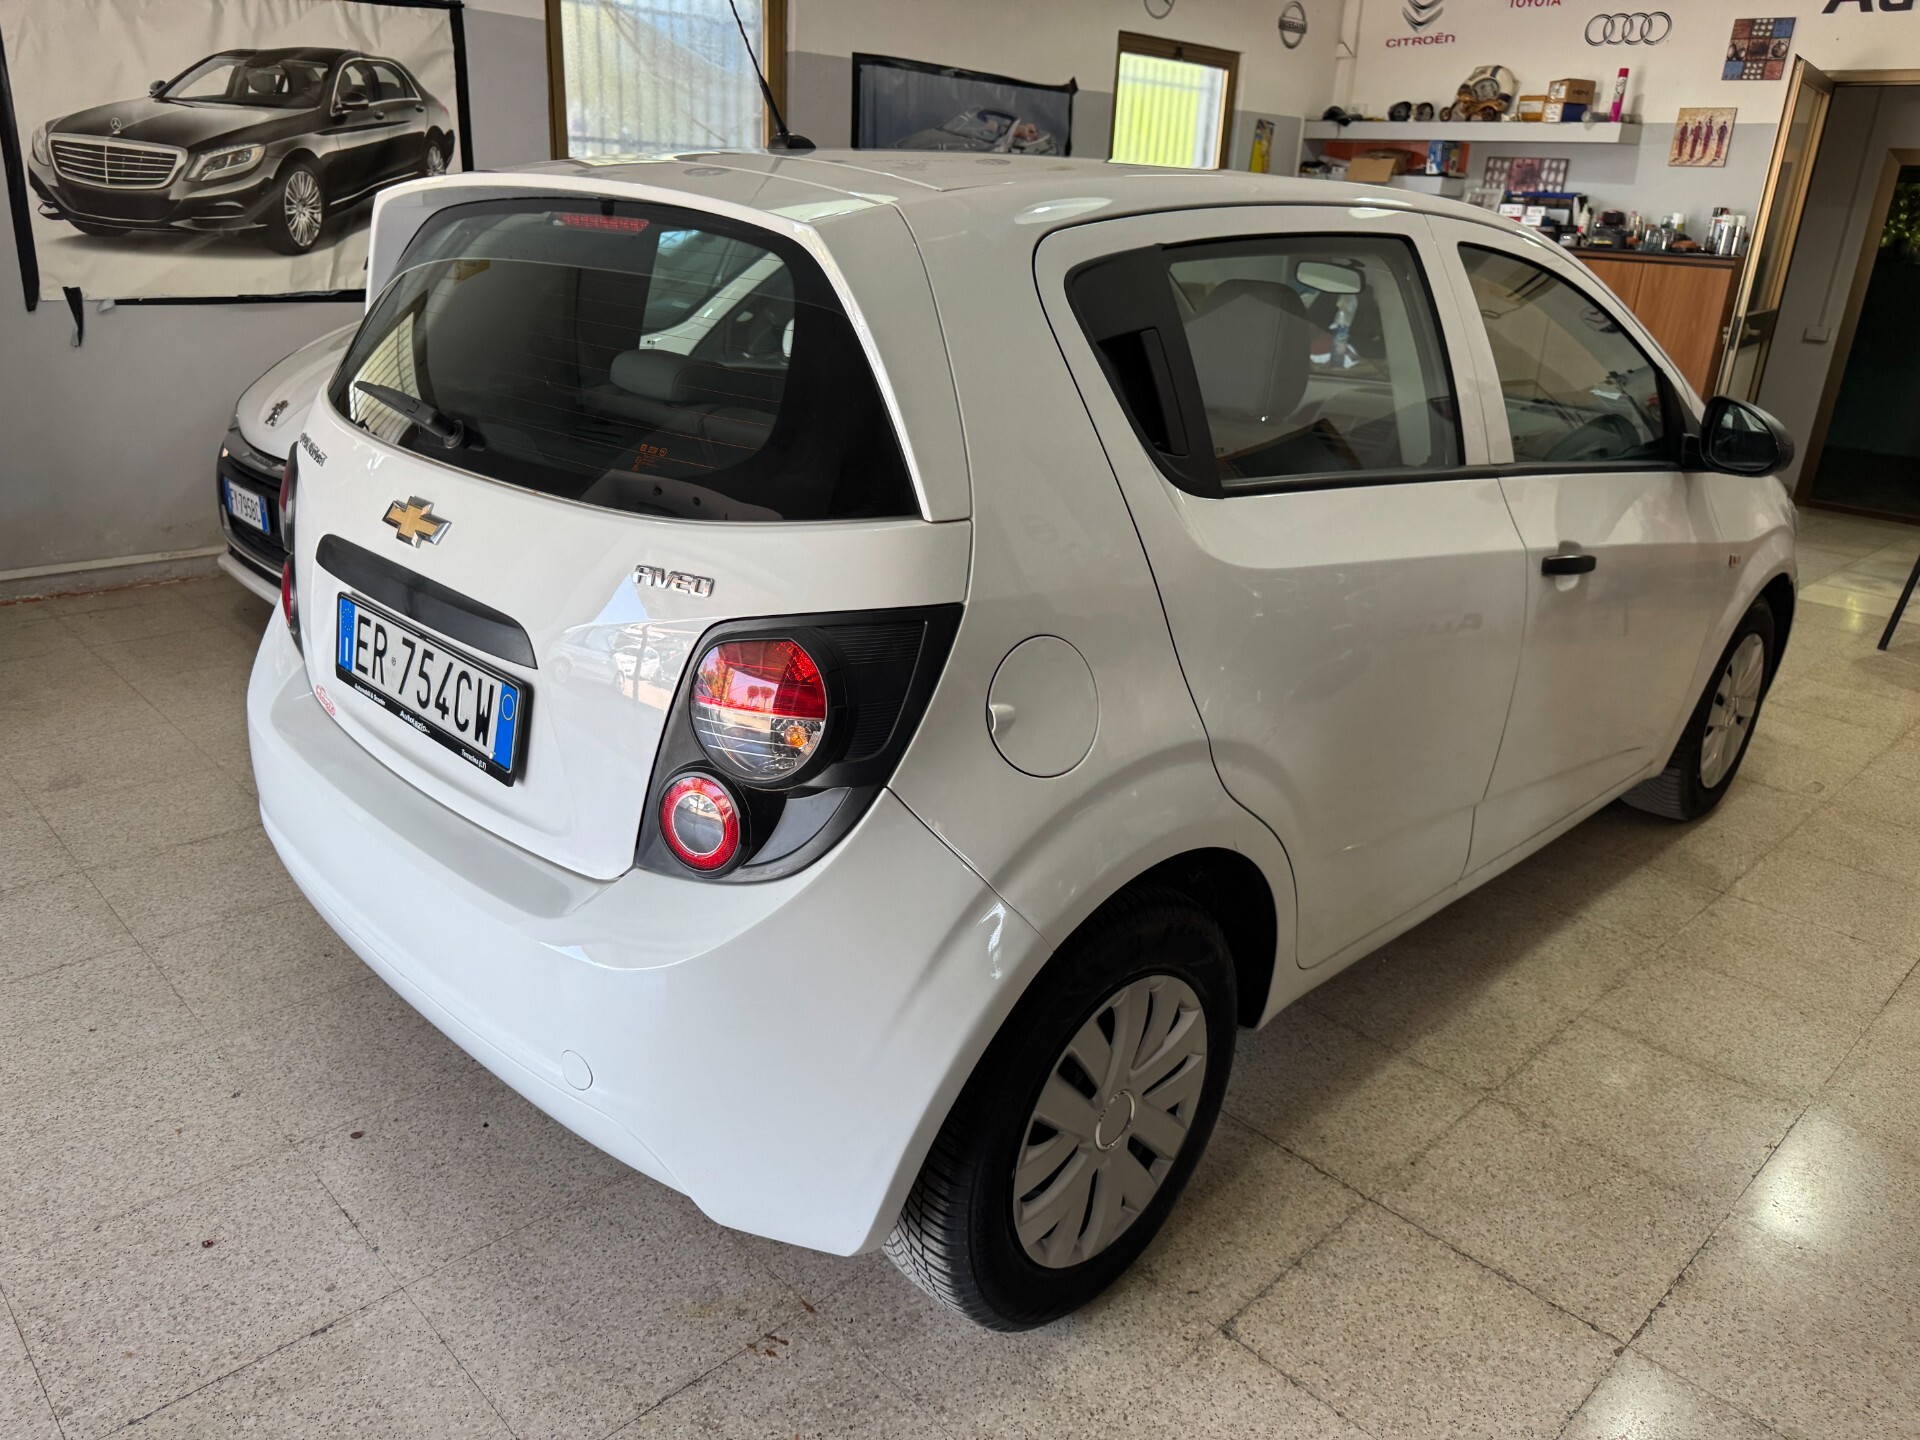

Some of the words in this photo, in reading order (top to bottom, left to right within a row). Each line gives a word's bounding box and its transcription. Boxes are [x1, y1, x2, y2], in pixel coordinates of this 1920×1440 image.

[1385, 32, 1456, 48] CITROËN
[632, 564, 715, 598] AVEO
[355, 614, 388, 685] ER
[399, 637, 494, 747] 754CW
